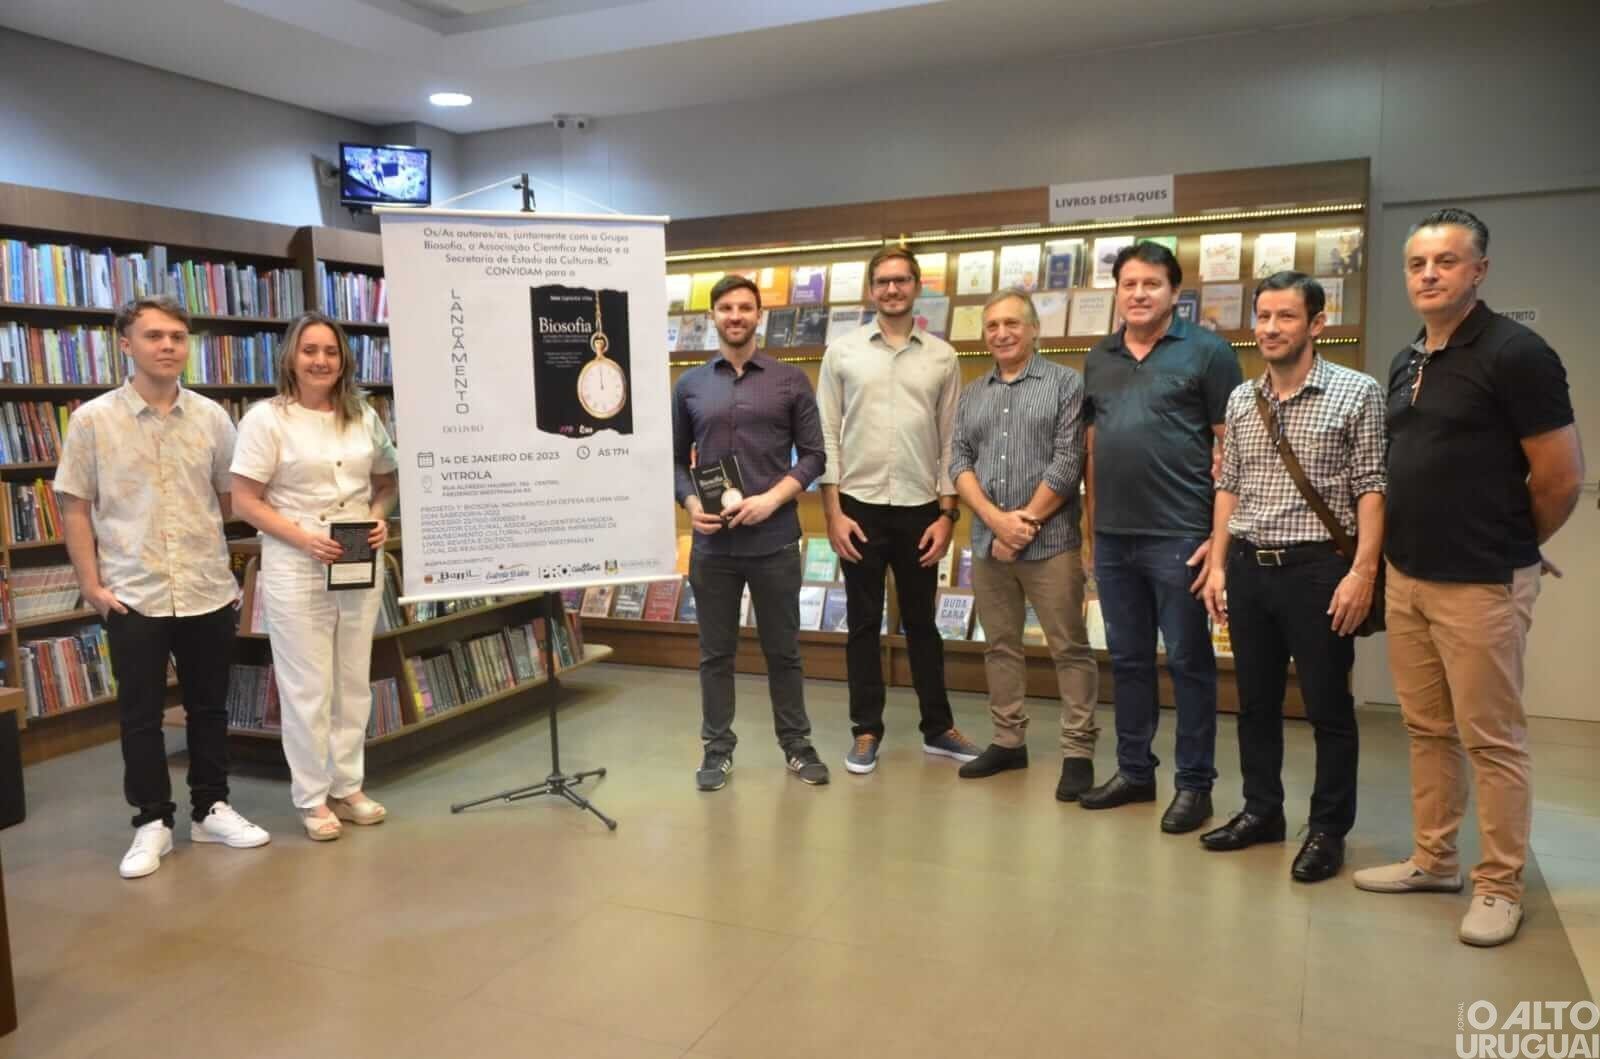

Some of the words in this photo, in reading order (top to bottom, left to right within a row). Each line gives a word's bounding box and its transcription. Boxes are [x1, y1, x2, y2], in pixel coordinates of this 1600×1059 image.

[1055, 195, 1096, 209] LIVROS
[1099, 189, 1168, 205] DESTAQUES
[423, 228, 454, 238] Os/As
[513, 231, 566, 242] juntamente
[568, 233, 589, 241] com
[599, 233, 629, 244] Grupo
[478, 242, 531, 253] Associação
[532, 243, 577, 253] Científica
[578, 245, 613, 254] Medeia
[445, 254, 494, 264] Secretaria
[496, 254, 509, 264] de
[511, 255, 543, 264] Estado
[544, 256, 557, 265] da
[485, 266, 543, 276] CONVIDAM
[545, 269, 567, 278] para
[538, 316, 592, 333] Biosofia
[613, 447, 630, 456] 17H
[440, 456, 451, 465] 14
[454, 455, 470, 464] DE
[472, 453, 517, 464] JANEIRO
[519, 452, 533, 462] DE
[535, 451, 560, 461] 2023
[440, 471, 492, 481] VITROLA
